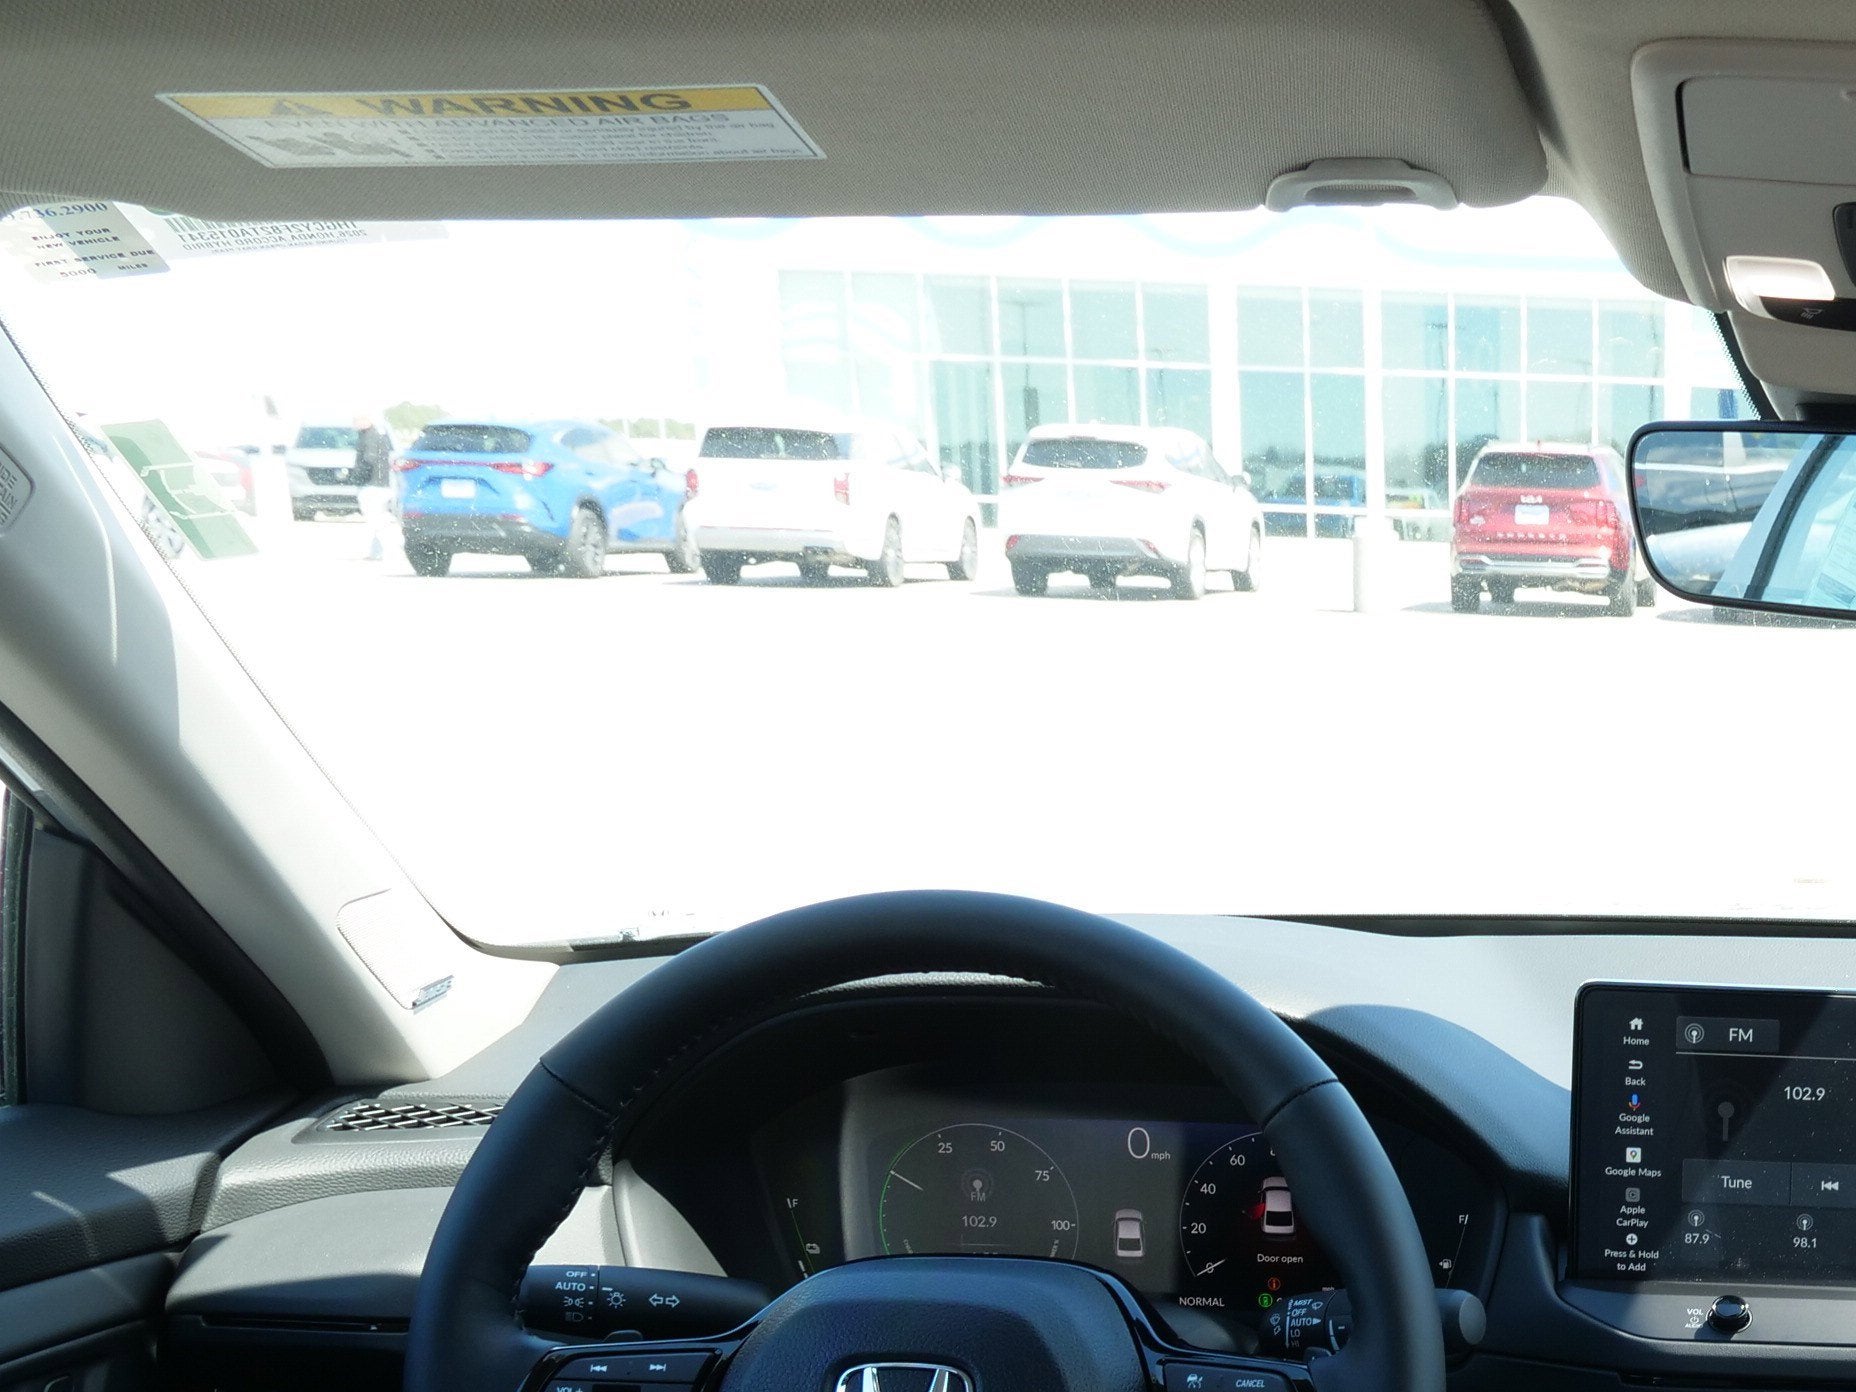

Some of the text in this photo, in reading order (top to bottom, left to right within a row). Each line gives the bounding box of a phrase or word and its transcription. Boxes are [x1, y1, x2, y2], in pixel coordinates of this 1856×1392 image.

[354, 92, 693, 116] WARNING
[69, 236, 121, 247] VEHICLE
[74, 252, 127, 263] SERVICE
[118, 263, 148, 271] MILES
[1729, 1027, 1754, 1043] FM
[1622, 1036, 1650, 1046] Home
[1625, 1077, 1646, 1086] Back
[1783, 1086, 1826, 1101] 102.9
[1618, 1113, 1650, 1123] Google
[1614, 1126, 1654, 1136] Assistant
[937, 1142, 953, 1154] 25
[989, 1140, 1006, 1152] 50
[1127, 1127, 1171, 1162] 0 mph
[1229, 1153, 1246, 1167] 60
[1034, 1170, 1050, 1182] 75
[1605, 1166, 1662, 1178] Google Maps
[1721, 1175, 1752, 1189] Tune
[1200, 1182, 1216, 1195] 40
[1619, 1205, 1646, 1216] Apple
[962, 1215, 998, 1229] 102.9
[1051, 1219, 1071, 1231] 100
[1616, 1217, 1649, 1229] CarPlay
[1190, 1222, 1207, 1235] 20
[1684, 1233, 1710, 1245] 87.9
[1792, 1237, 1817, 1248] 98.1
[1257, 1253, 1304, 1266] Door open
[1604, 1249, 1659, 1260] Press & Hold
[1616, 1262, 1647, 1272] to Add
[565, 1270, 588, 1279] OFF
[555, 1281, 587, 1292] AUTO
[1179, 1296, 1225, 1308] NORMAL
[1291, 1308, 1307, 1317] OFF
[1686, 1308, 1704, 1316] VOL
[1290, 1317, 1312, 1327] AUTO
[1290, 1328, 1301, 1338] LO
[1235, 1379, 1266, 1388] CANCEL
